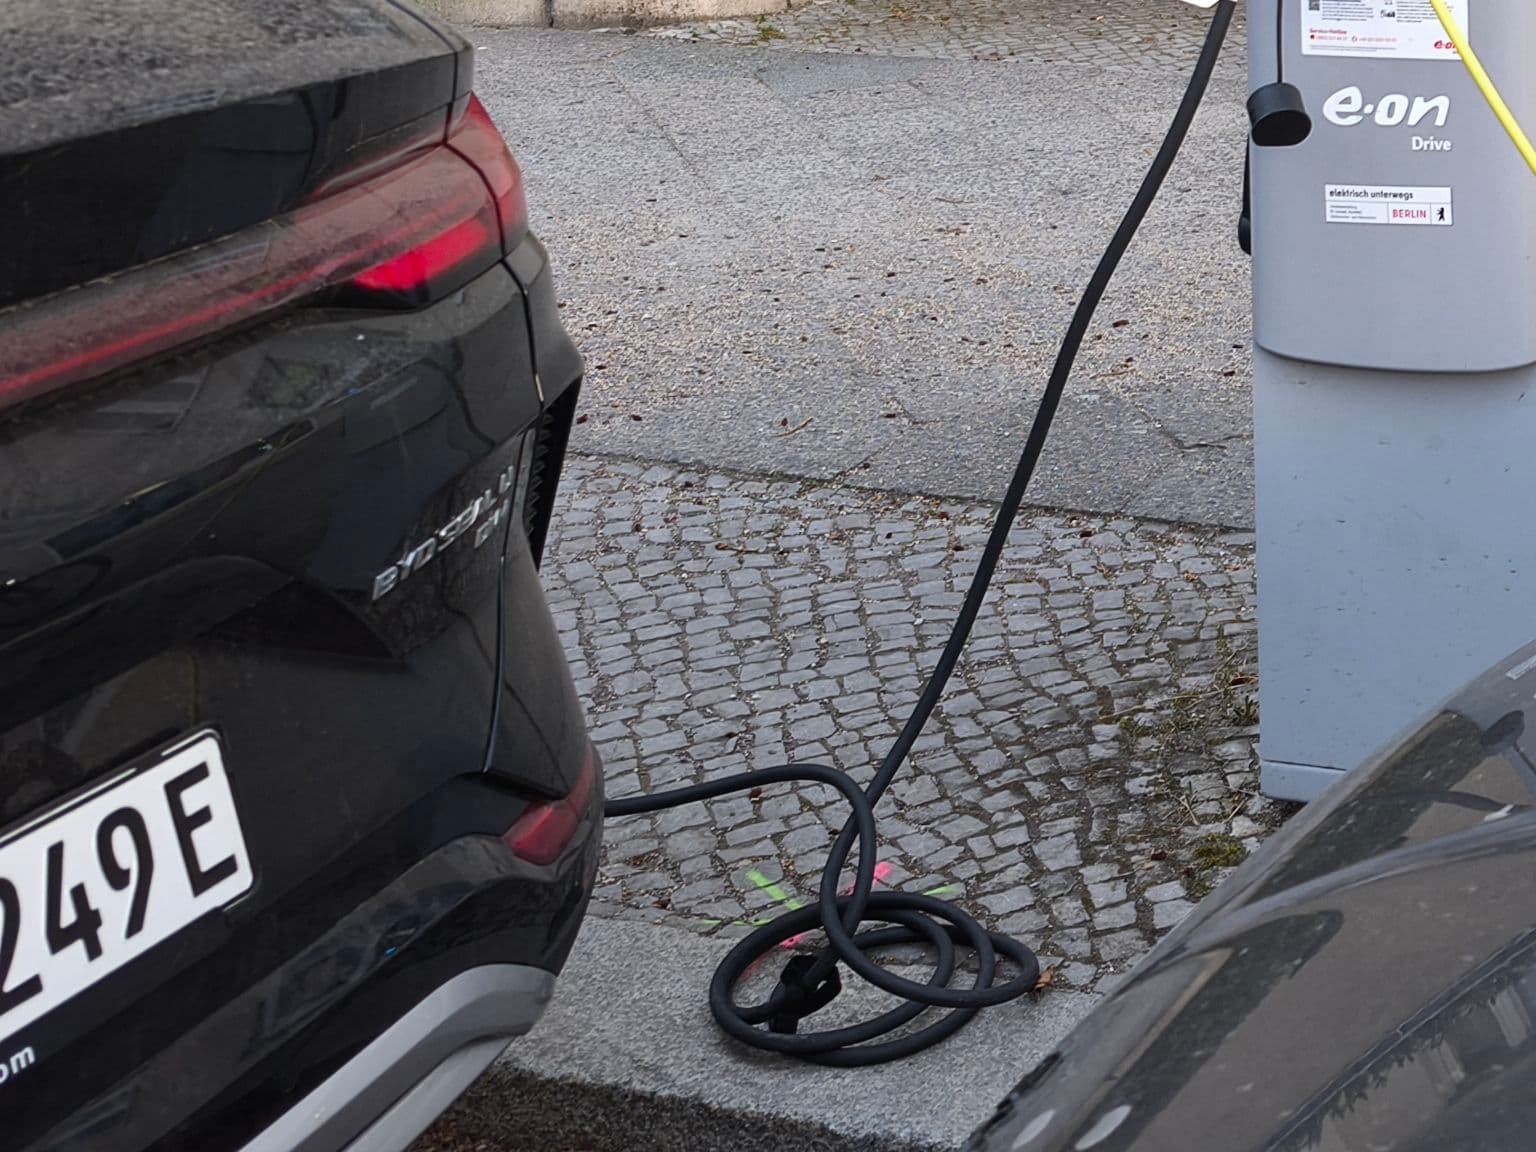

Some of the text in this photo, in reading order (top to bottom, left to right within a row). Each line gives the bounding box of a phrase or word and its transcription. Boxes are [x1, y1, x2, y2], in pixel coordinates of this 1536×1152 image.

[1411, 135, 1452, 151] Drive
[1329, 188, 1414, 201] elektrisch unterwegs
[1392, 209, 1427, 219] BERLIN
[0, 761, 238, 1018] 249E
